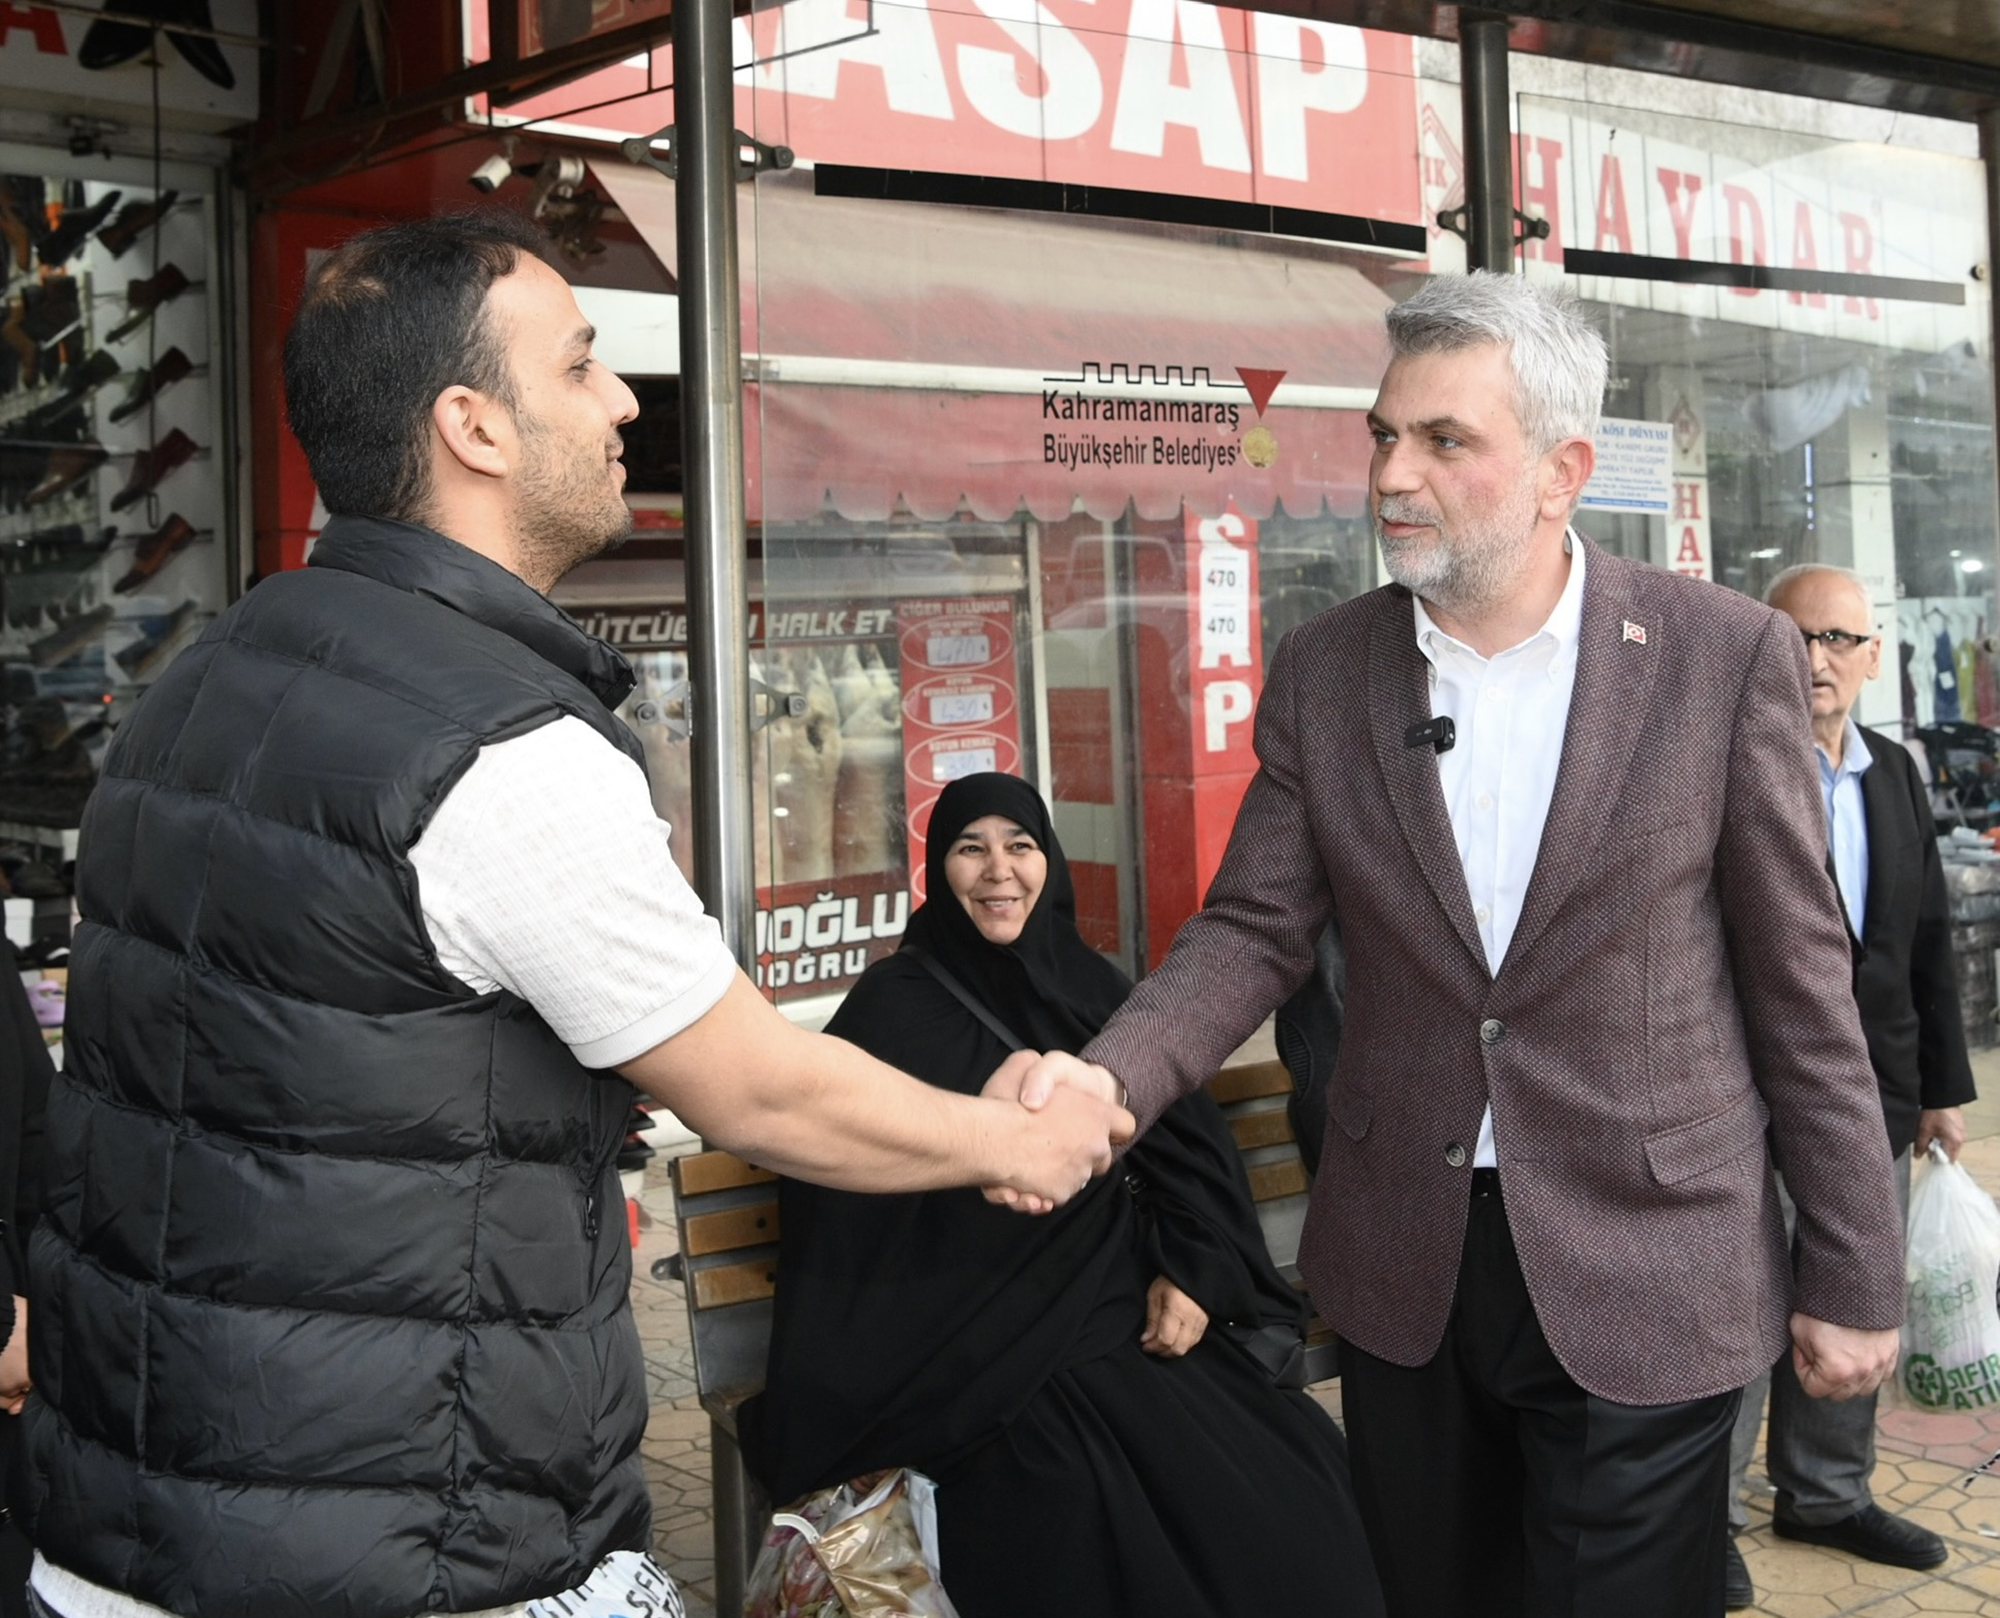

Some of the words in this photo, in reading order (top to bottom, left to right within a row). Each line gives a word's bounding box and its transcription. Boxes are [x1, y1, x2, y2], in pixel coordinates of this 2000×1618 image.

[622, 0, 1368, 182] ASAP
[1511, 133, 1880, 320] HAYDAR
[1043, 390, 1240, 432] Kahramanmaraş
[1043, 433, 1147, 472] Büyükşehir
[1207, 570, 1236, 587] 470
[766, 610, 847, 638] HALK
[854, 608, 893, 634] ET
[1207, 618, 1236, 634] 470
[757, 948, 866, 988] OĞRU
[1954, 1379, 2000, 1411] ATI
